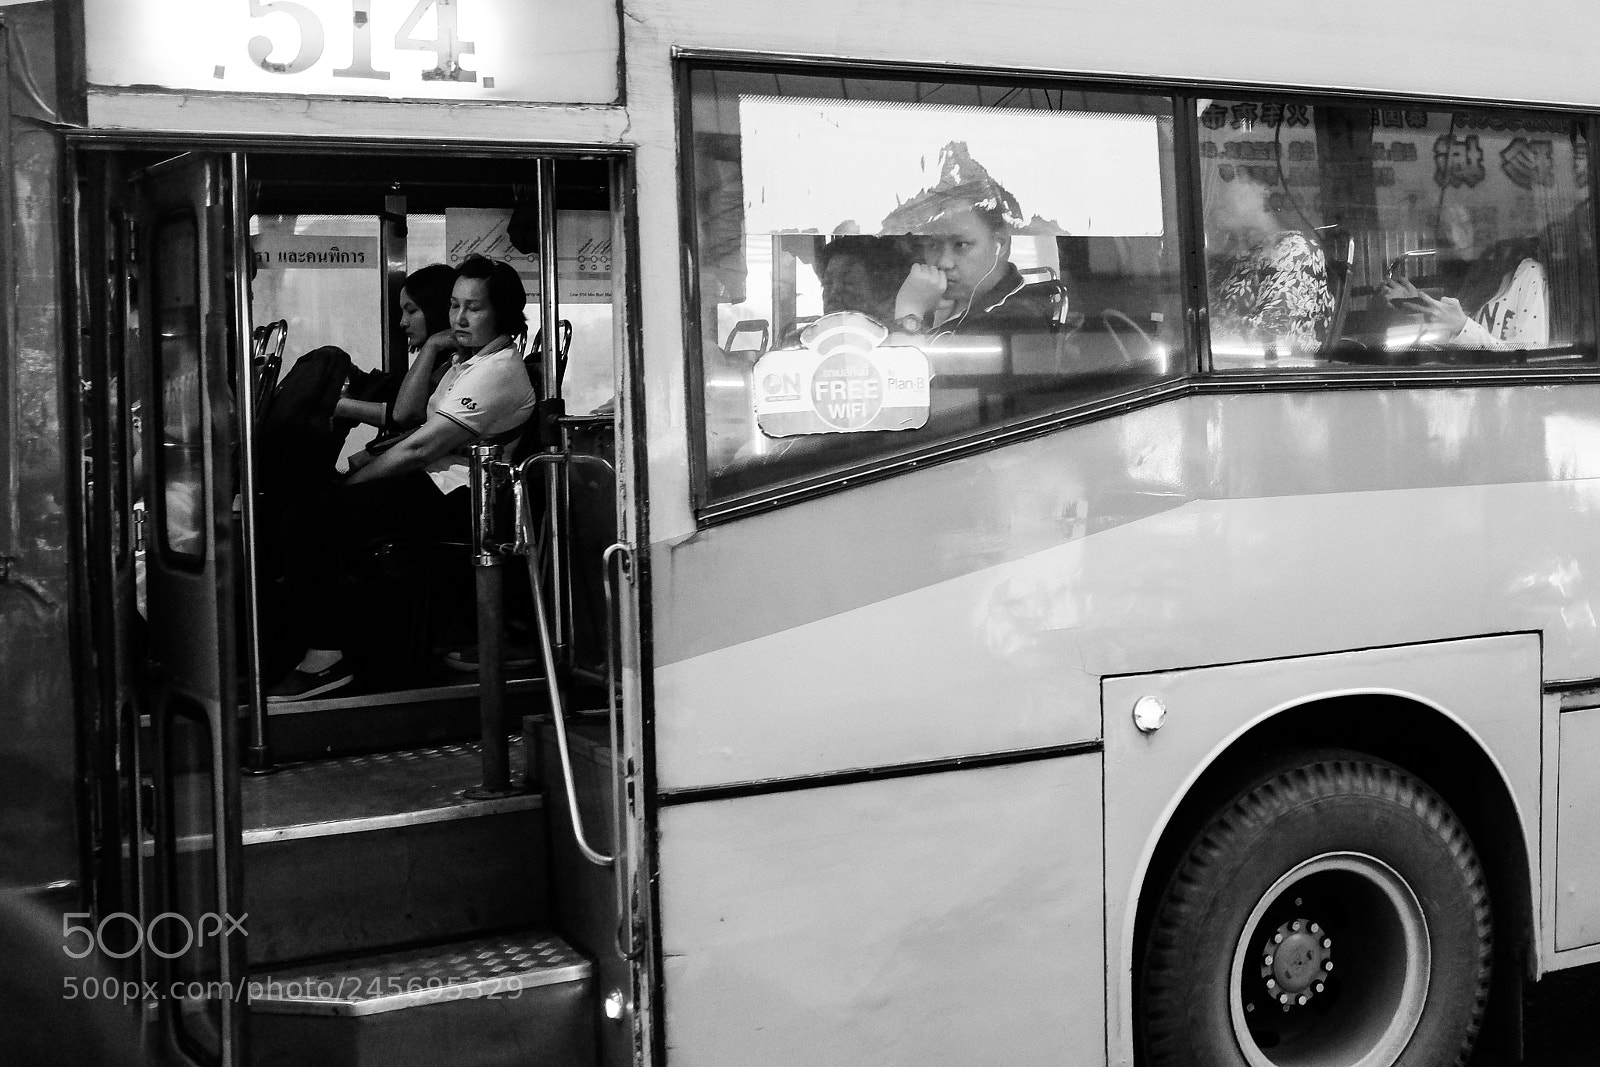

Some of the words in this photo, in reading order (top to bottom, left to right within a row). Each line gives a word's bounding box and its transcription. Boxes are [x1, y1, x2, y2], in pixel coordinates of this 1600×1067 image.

[277, 246, 365, 264] และคนพิการ
[815, 378, 879, 401] FREE
[828, 402, 866, 420] WIFI
